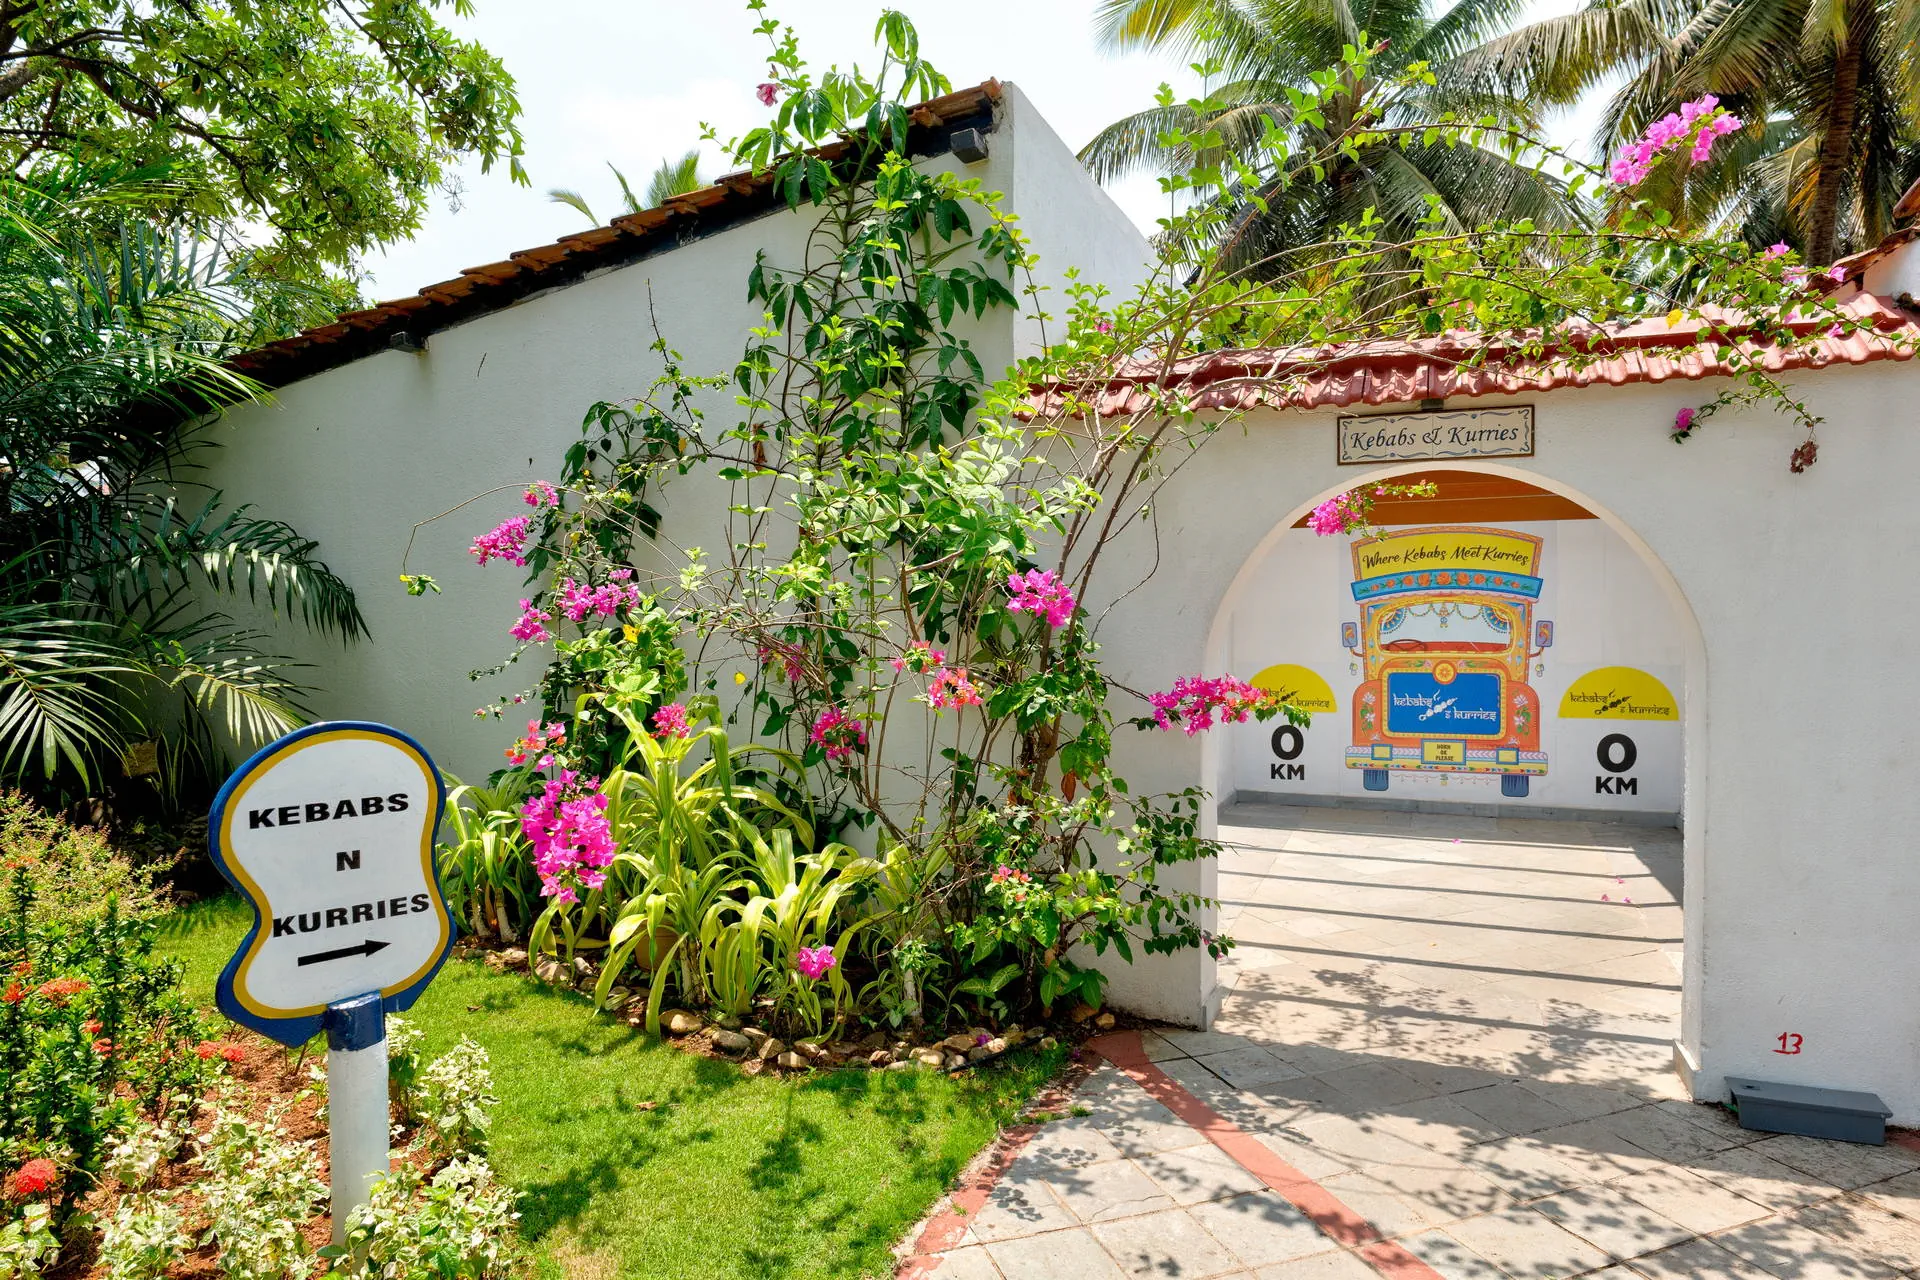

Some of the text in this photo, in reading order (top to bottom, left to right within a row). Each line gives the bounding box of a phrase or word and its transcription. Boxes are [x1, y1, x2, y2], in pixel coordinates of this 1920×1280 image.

[1350, 423, 1519, 450] Kebabs & Kurries
[1362, 544, 1529, 569] Where Kebabs Meet Kurries
[1392, 693, 1433, 707] kebabs
[1570, 692, 1608, 703] kebabs
[1453, 706, 1497, 721] kurries
[1628, 703, 1670, 715] kurries
[1270, 763, 1305, 781] KM
[1595, 776, 1638, 796] KM
[249, 793, 409, 829] KEBABS
[336, 850, 361, 872] N
[272, 893, 430, 938] KURRIES
[1772, 1032, 1804, 1055] 13
